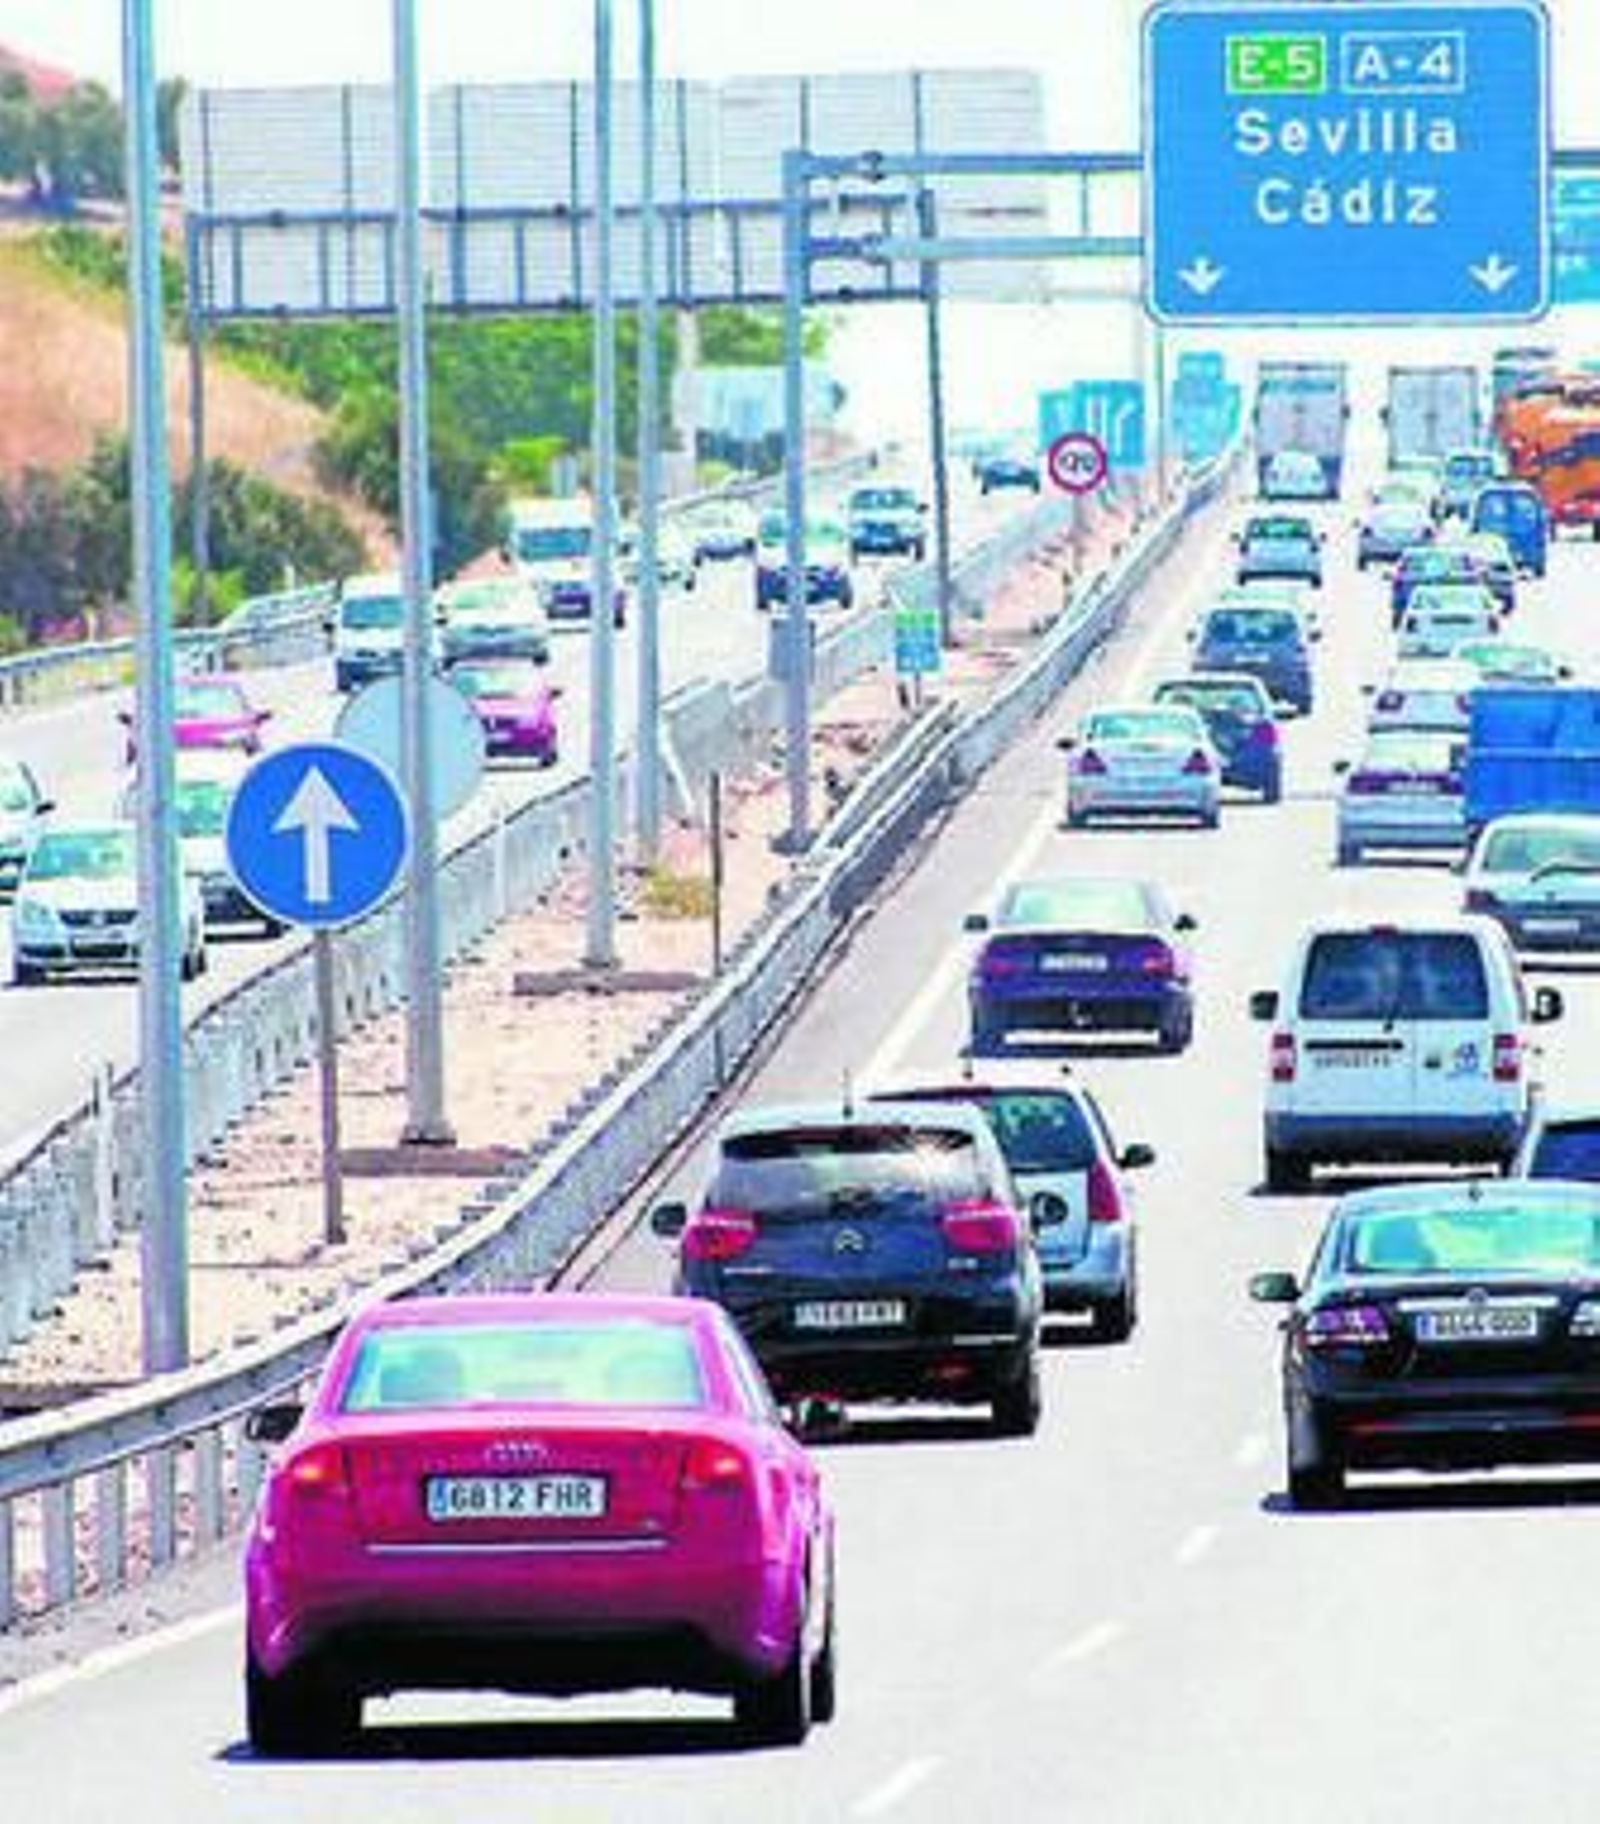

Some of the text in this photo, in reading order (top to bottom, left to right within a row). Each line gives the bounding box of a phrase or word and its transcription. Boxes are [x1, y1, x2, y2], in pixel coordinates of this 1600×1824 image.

[1238, 45, 1317, 82] E-5
[1354, 42, 1453, 82] A-4
[1235, 109, 1458, 153] Sevilla
[1256, 177, 1438, 224] Cádiz
[536, 1480, 593, 1511] FHR
